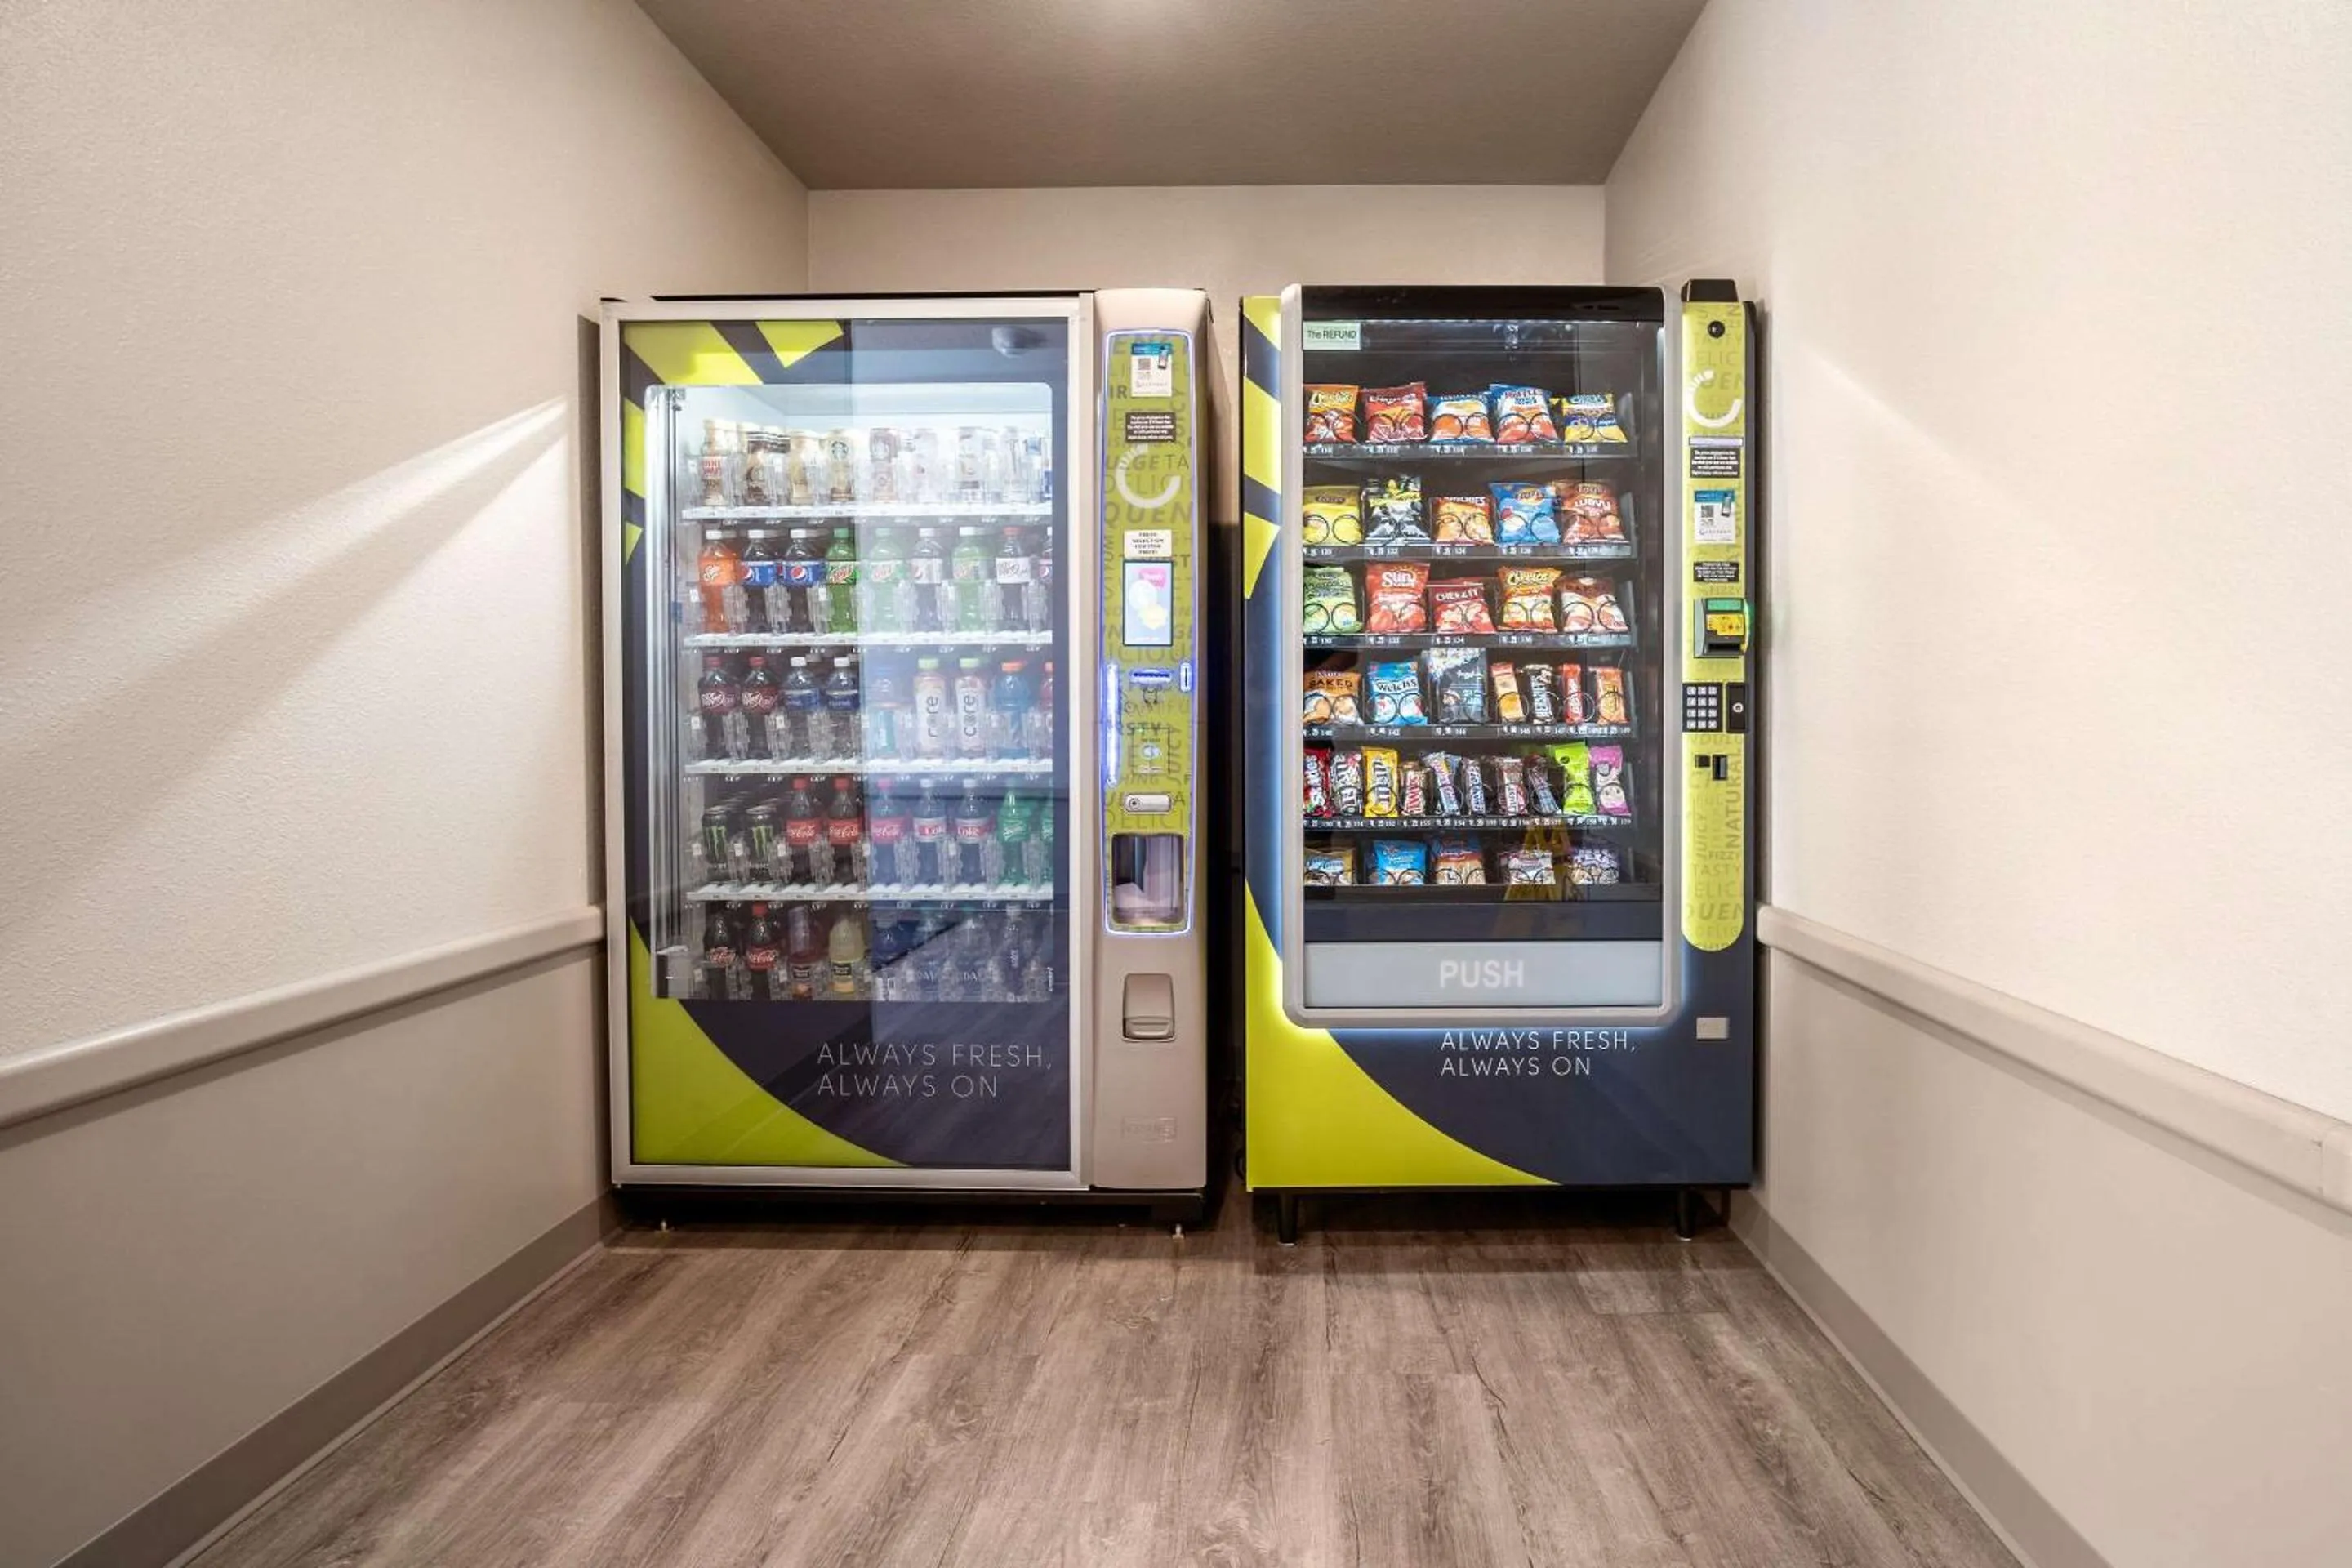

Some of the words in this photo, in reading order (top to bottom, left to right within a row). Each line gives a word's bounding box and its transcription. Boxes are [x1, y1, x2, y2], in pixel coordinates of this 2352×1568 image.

[1323, 329, 1357, 340] REFUND
[1439, 959, 1525, 989] PUSH
[1440, 1031, 1540, 1051] ALWAYS
[1552, 1031, 1636, 1053] FRESH,
[817, 1042, 937, 1067] ALWAYS
[951, 1044, 1052, 1070] FRESH,
[1440, 1056, 1540, 1076] ALWAYS
[1551, 1056, 1591, 1076] ON
[817, 1073, 937, 1097] ALWAYS
[951, 1074, 997, 1098] ON
